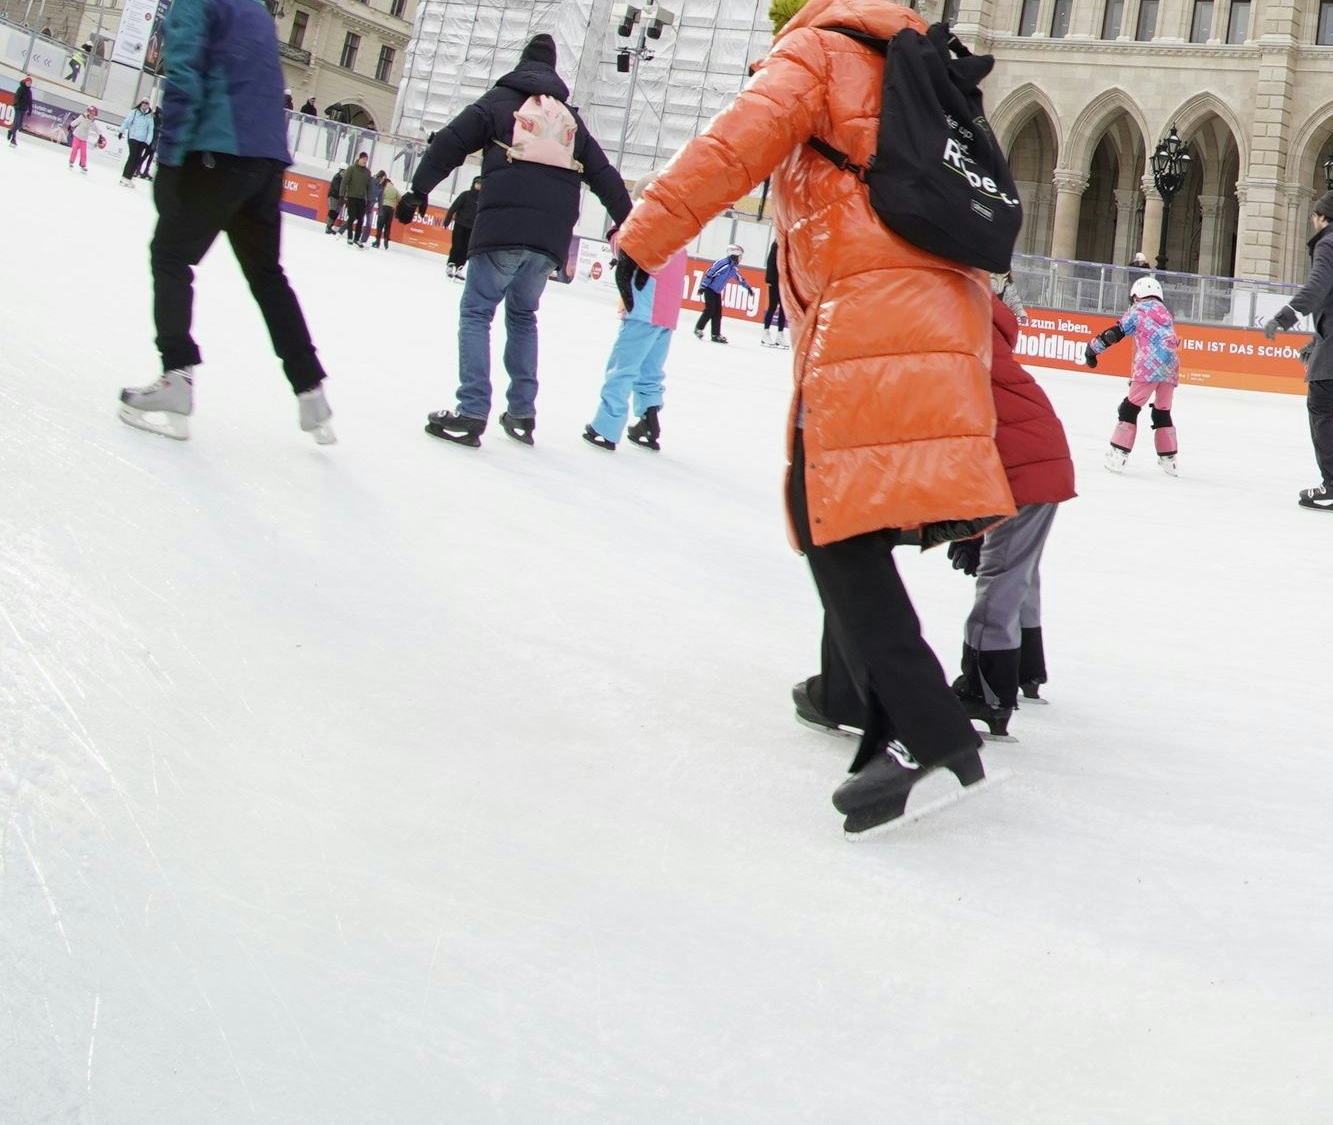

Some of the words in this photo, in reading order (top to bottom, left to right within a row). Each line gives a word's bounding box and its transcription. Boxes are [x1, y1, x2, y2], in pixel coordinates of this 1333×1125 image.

[1031, 318, 1055, 330] zum
[1058, 318, 1092, 335] leben.
[1207, 341, 1226, 353] IST
[1229, 343, 1254, 355] DAS
